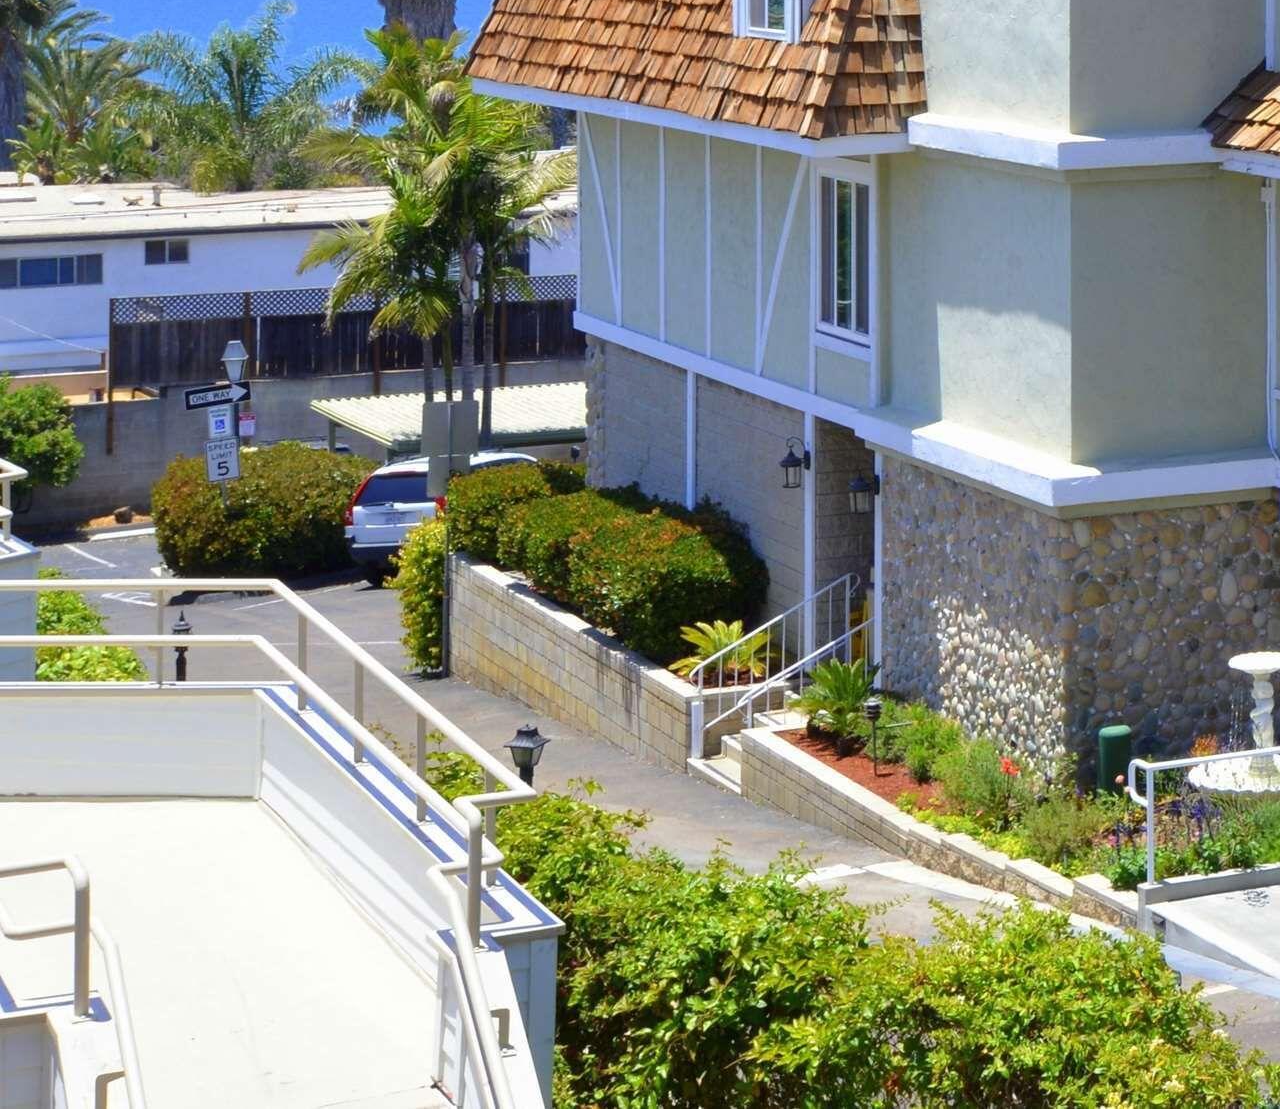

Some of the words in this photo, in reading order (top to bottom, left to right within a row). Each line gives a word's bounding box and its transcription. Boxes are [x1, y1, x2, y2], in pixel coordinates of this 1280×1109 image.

[191, 393, 210, 404] ONE
[212, 389, 231, 400] WAY
[207, 441, 236, 452] SPEED
[211, 451, 233, 461] LIMIT
[217, 460, 230, 477] 5
